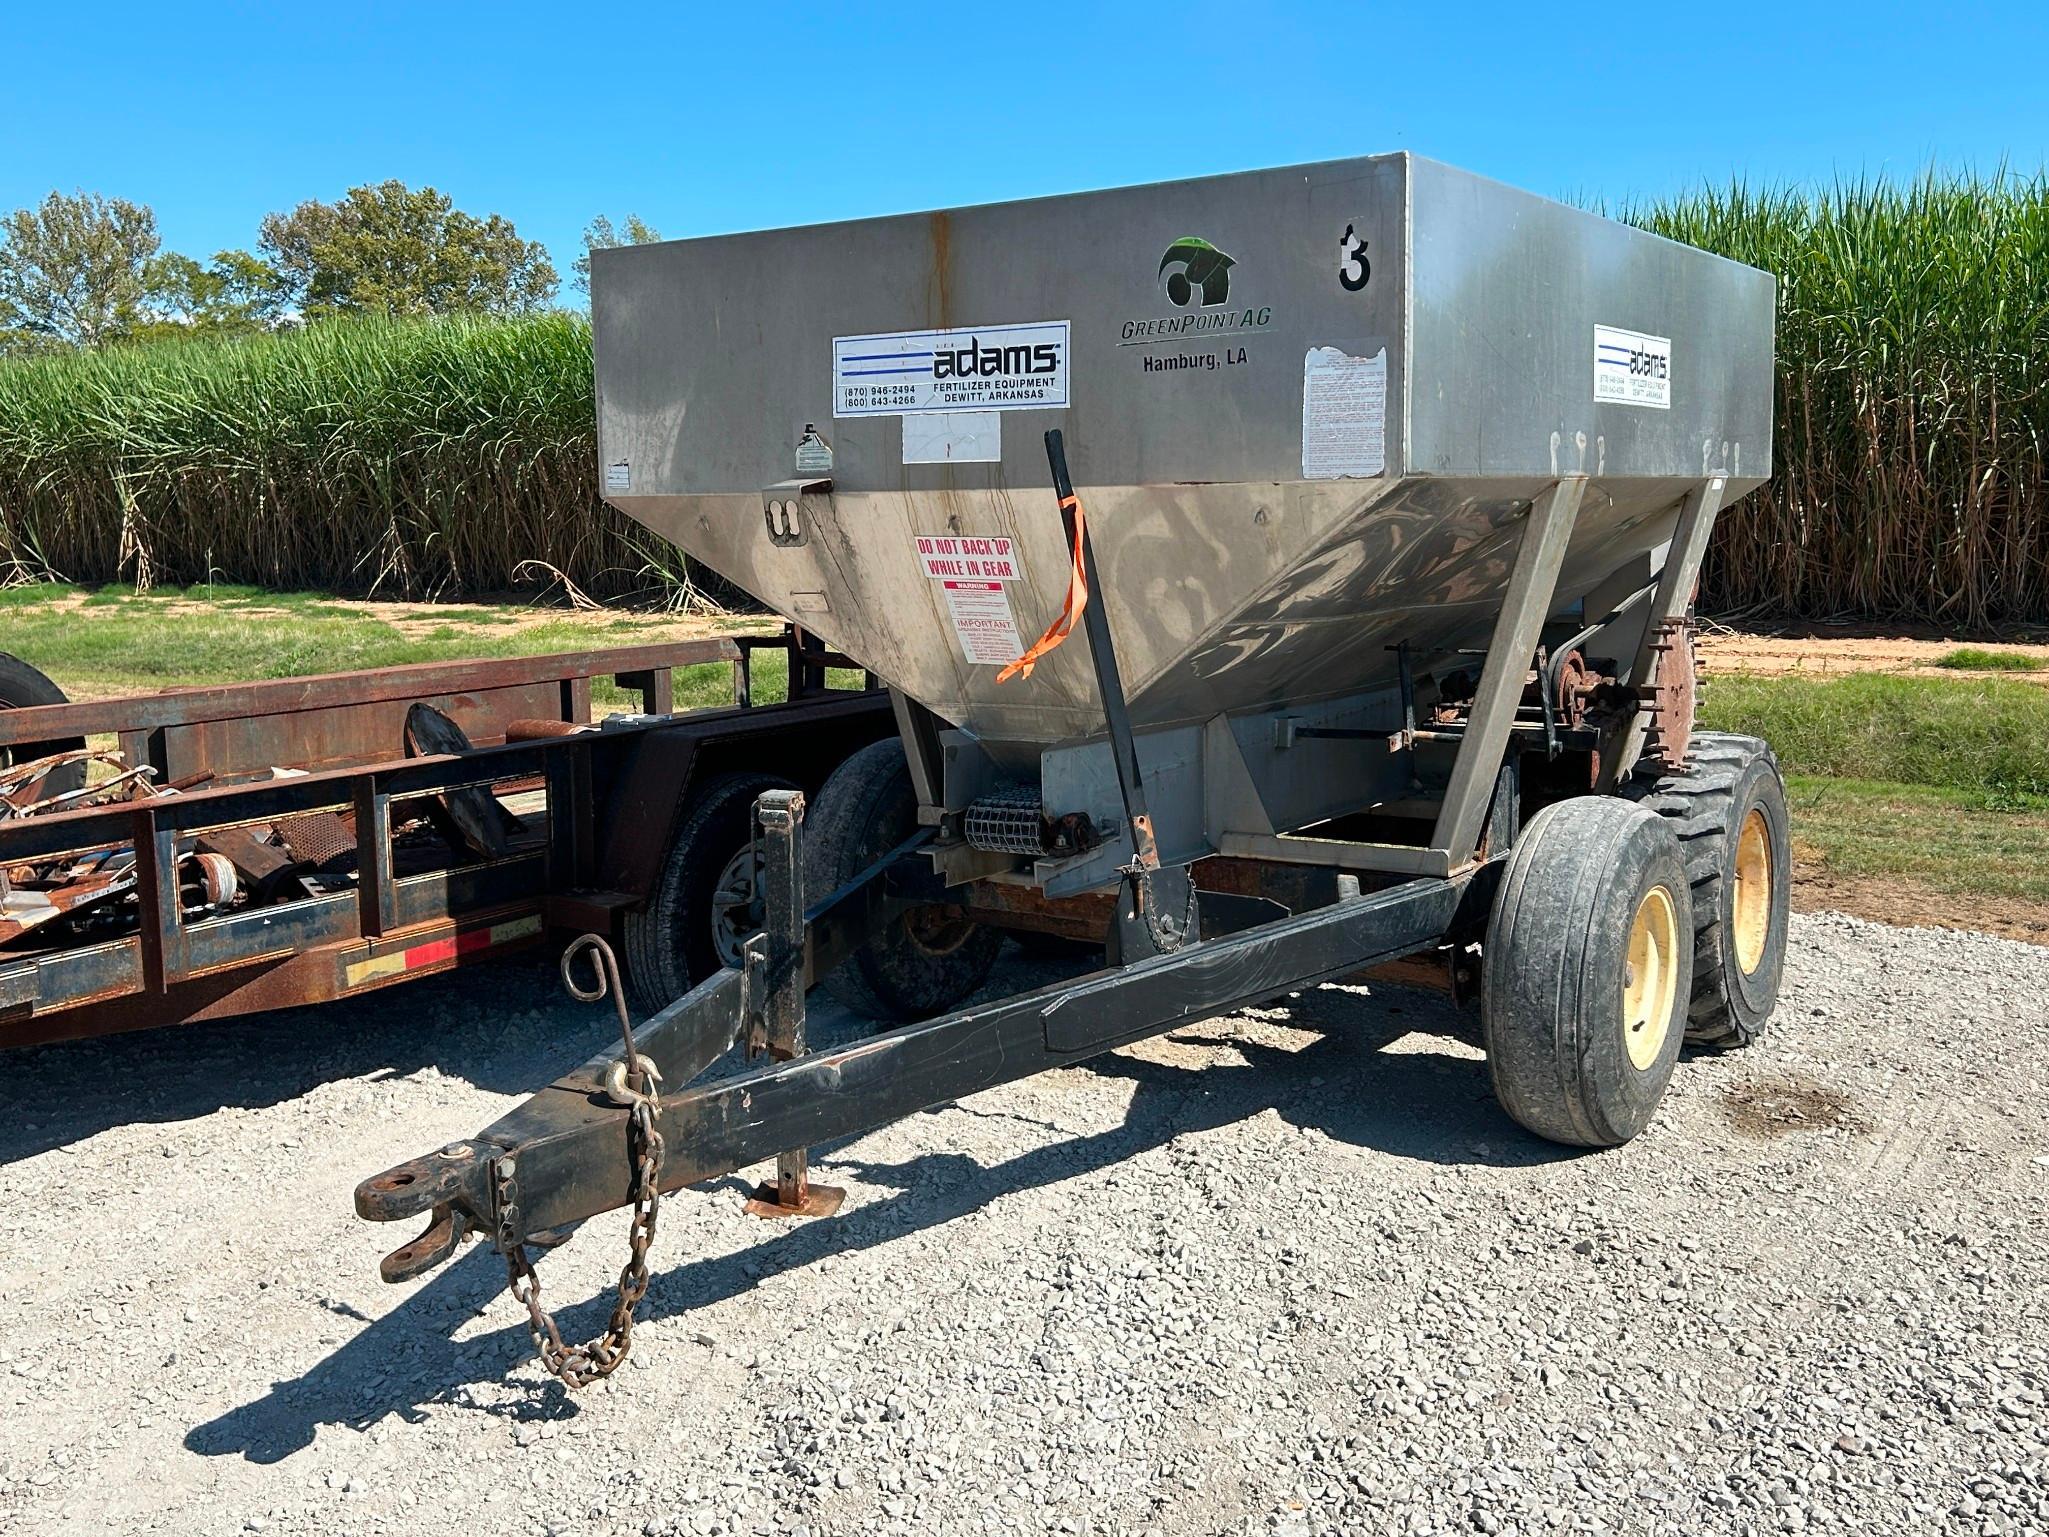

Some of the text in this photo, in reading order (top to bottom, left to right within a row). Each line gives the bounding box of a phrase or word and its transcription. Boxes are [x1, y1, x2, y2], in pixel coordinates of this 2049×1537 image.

[1240, 306, 1272, 328] AG
[933, 335, 1057, 379] adams
[1143, 347, 1249, 373] Hamburg, LA
[1629, 341, 1667, 379] adams
[844, 384, 916, 398] (870) 946-2494
[933, 377, 1056, 393] FERTILIZER EQUIPMENT
[845, 395, 916, 408] (800) 643-4266
[944, 389, 1044, 403] DEWITT, ARKANSAS
[917, 539, 1011, 556] DO NOT BACK UP
[927, 560, 1013, 577] WHILE IN GEAR
[956, 582, 989, 590] WARNING
[957, 620, 1010, 628] IMPORTANT
